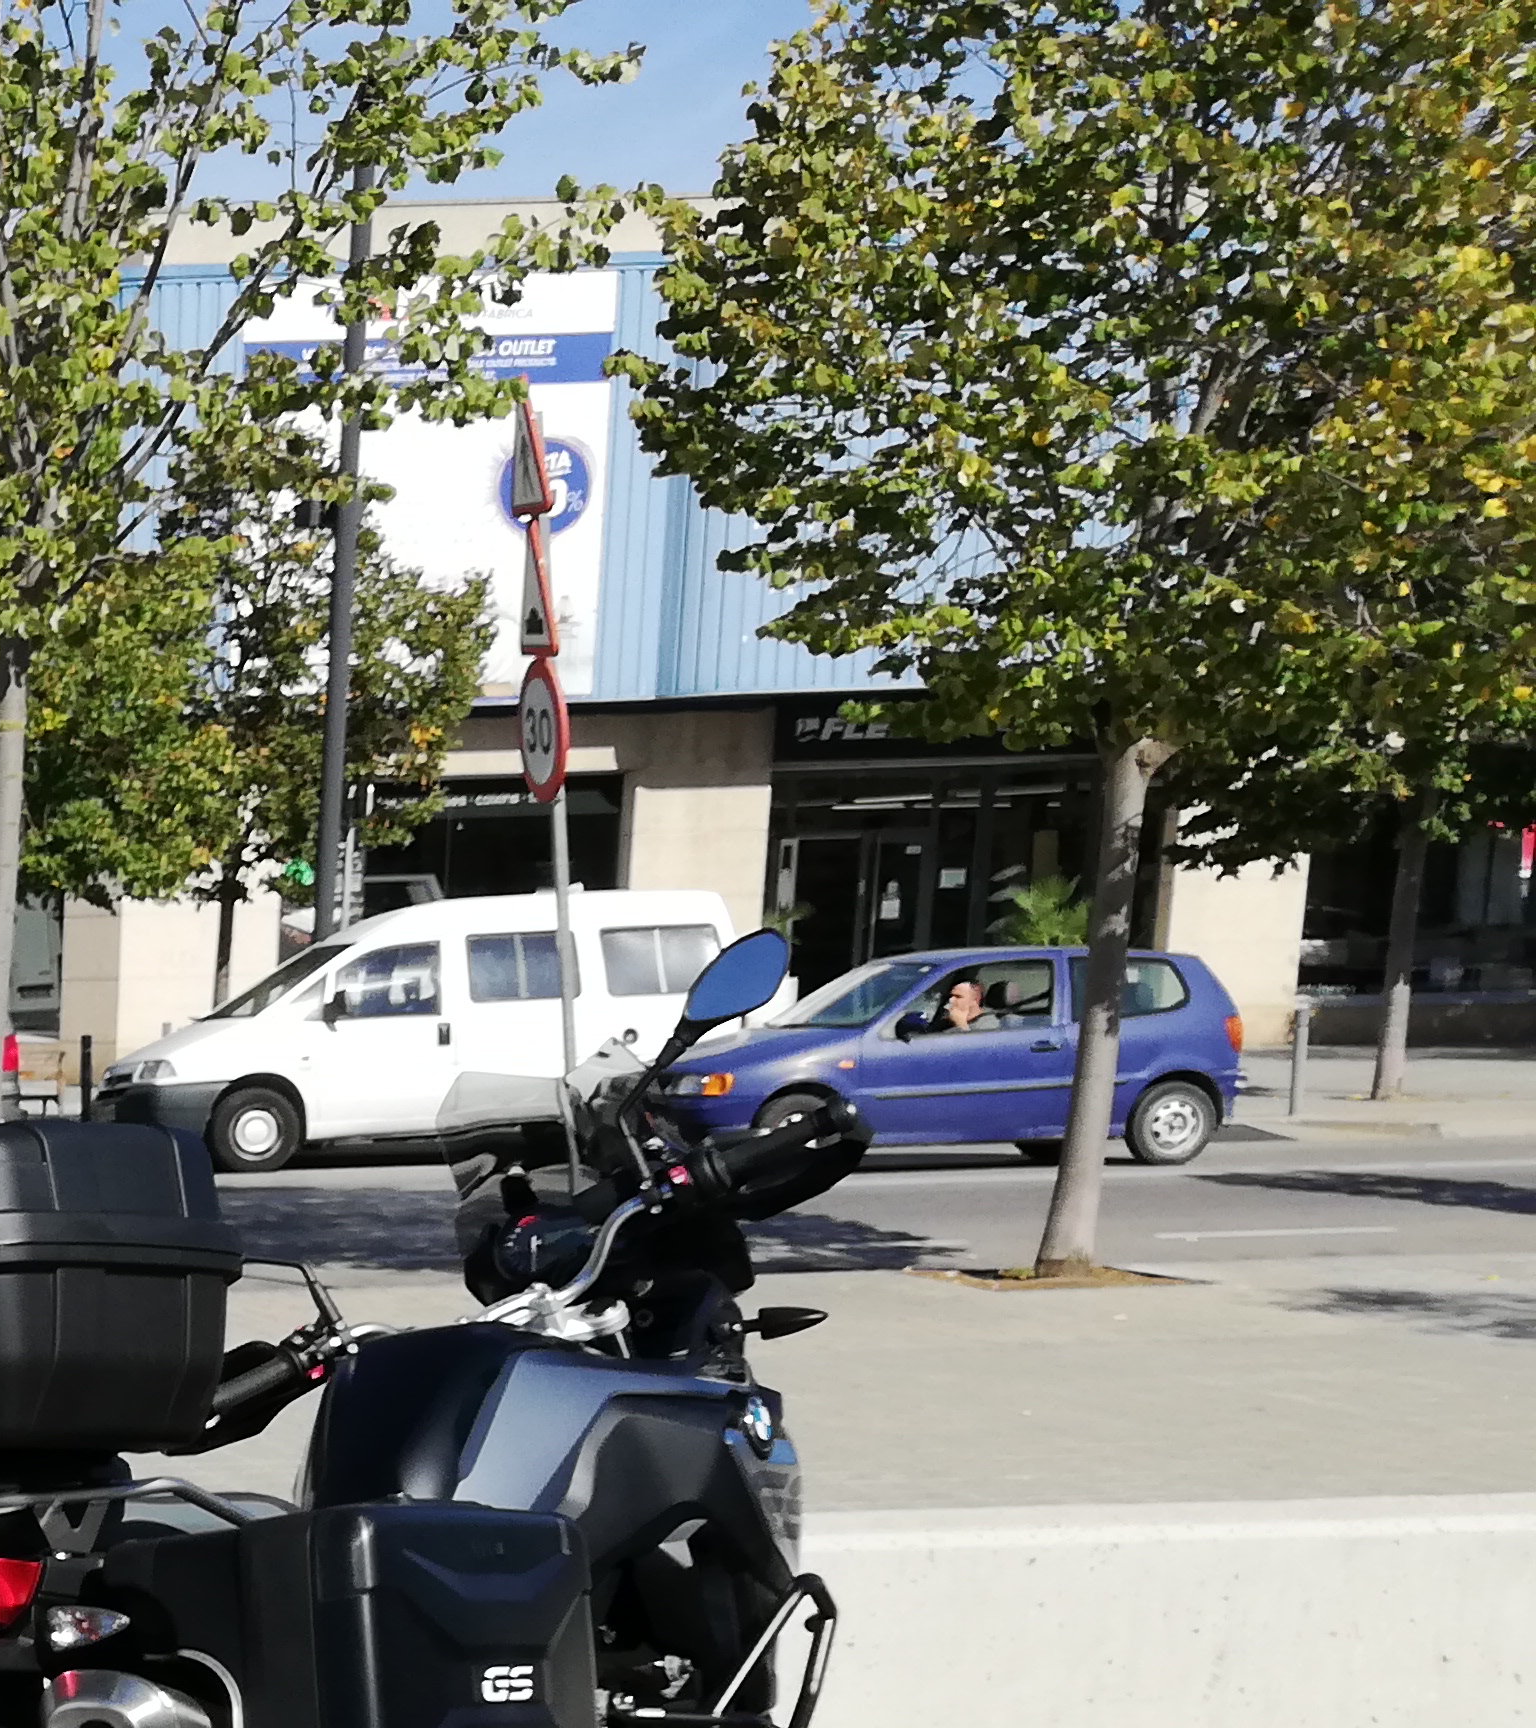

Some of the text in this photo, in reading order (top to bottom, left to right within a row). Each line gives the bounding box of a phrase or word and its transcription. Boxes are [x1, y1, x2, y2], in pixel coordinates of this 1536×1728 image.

[499, 338, 556, 356] OUTLET
[525, 707, 553, 755] 30
[820, 717, 890, 741] FLE
[481, 1665, 534, 1702] GS
